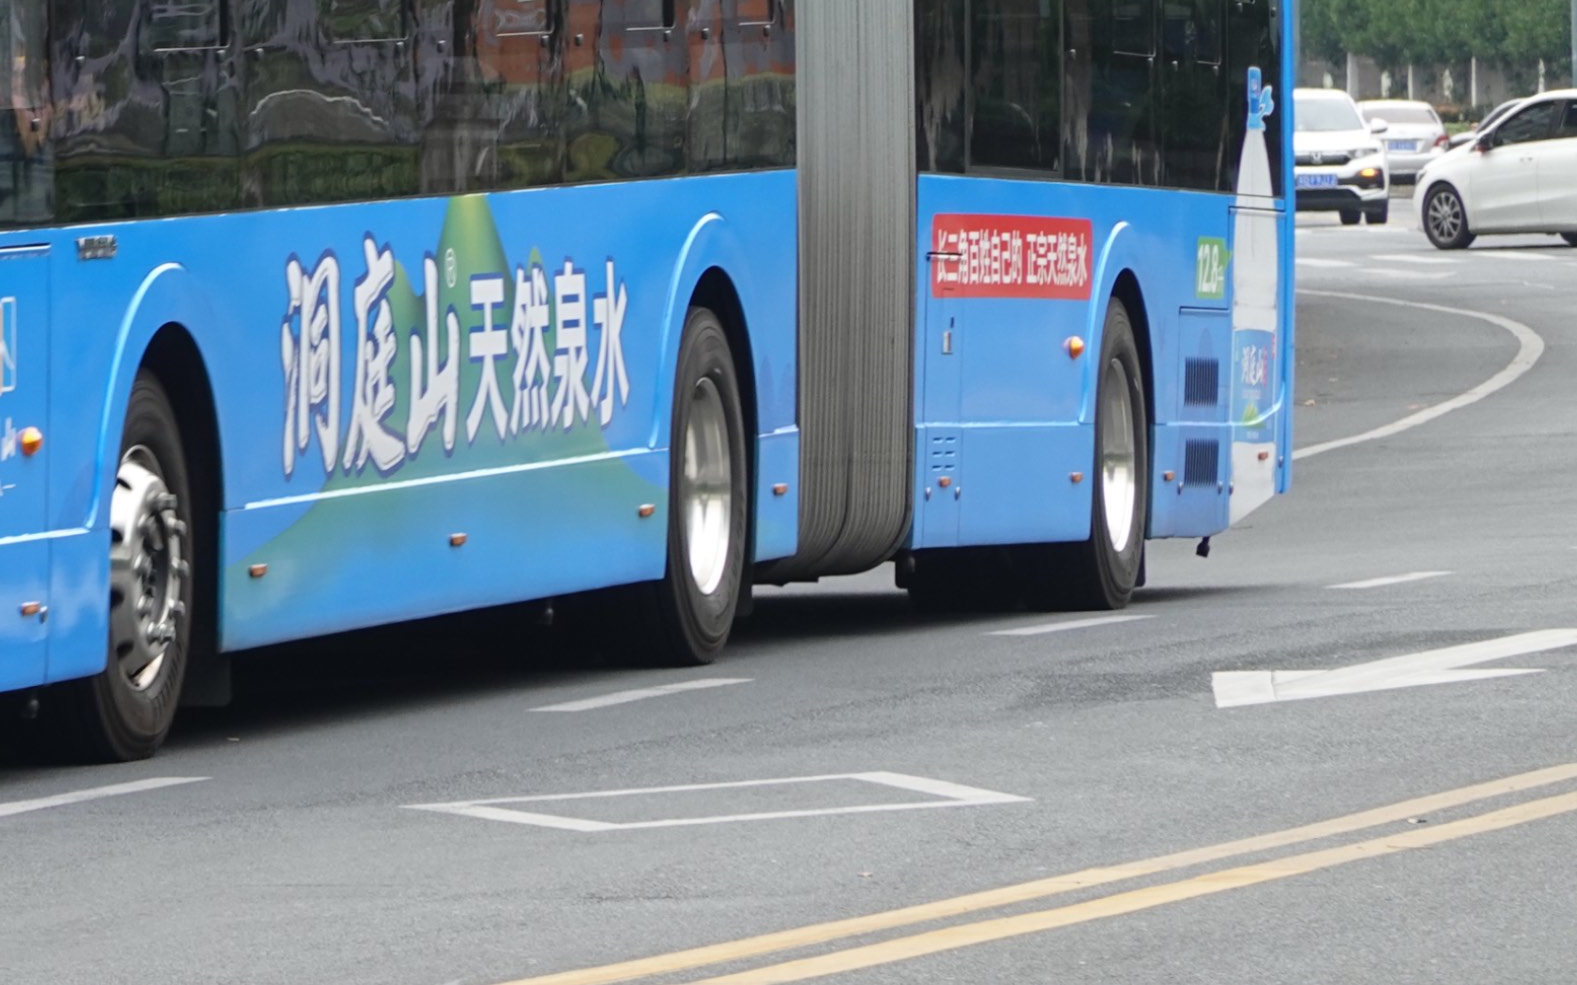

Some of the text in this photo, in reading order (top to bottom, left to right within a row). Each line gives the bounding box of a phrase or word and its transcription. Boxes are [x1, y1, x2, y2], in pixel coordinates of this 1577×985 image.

[1026, 230, 1087, 286] 正宗天然泉水
[281, 231, 630, 475] 洞庭山 天然泉水
